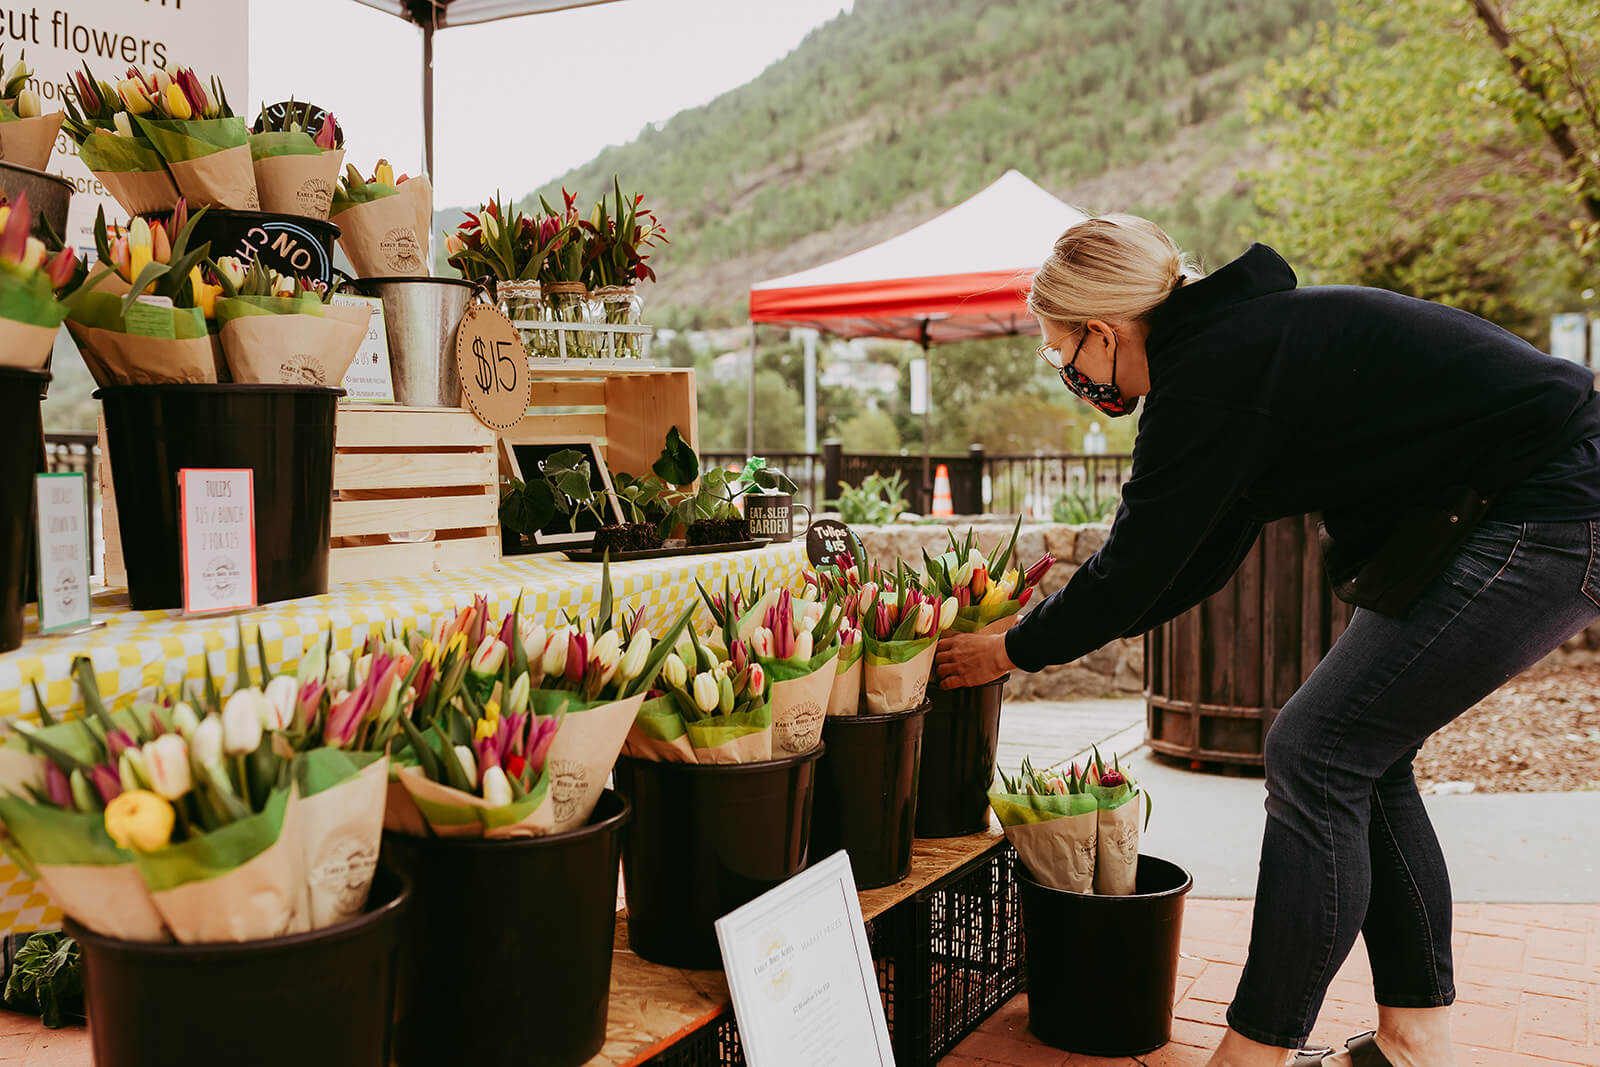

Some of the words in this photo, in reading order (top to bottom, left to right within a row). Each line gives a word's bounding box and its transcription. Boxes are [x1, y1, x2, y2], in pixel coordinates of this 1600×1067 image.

[51, 10, 168, 71] flowers
[471, 335, 518, 395] $15
[206, 480, 232, 498] TULIPS
[750, 506, 763, 519] EAT
[767, 506, 789, 519] SLEEP
[750, 519, 789, 534] GARDEN
[813, 525, 847, 541] Tulips
[825, 539, 847, 553] $15
